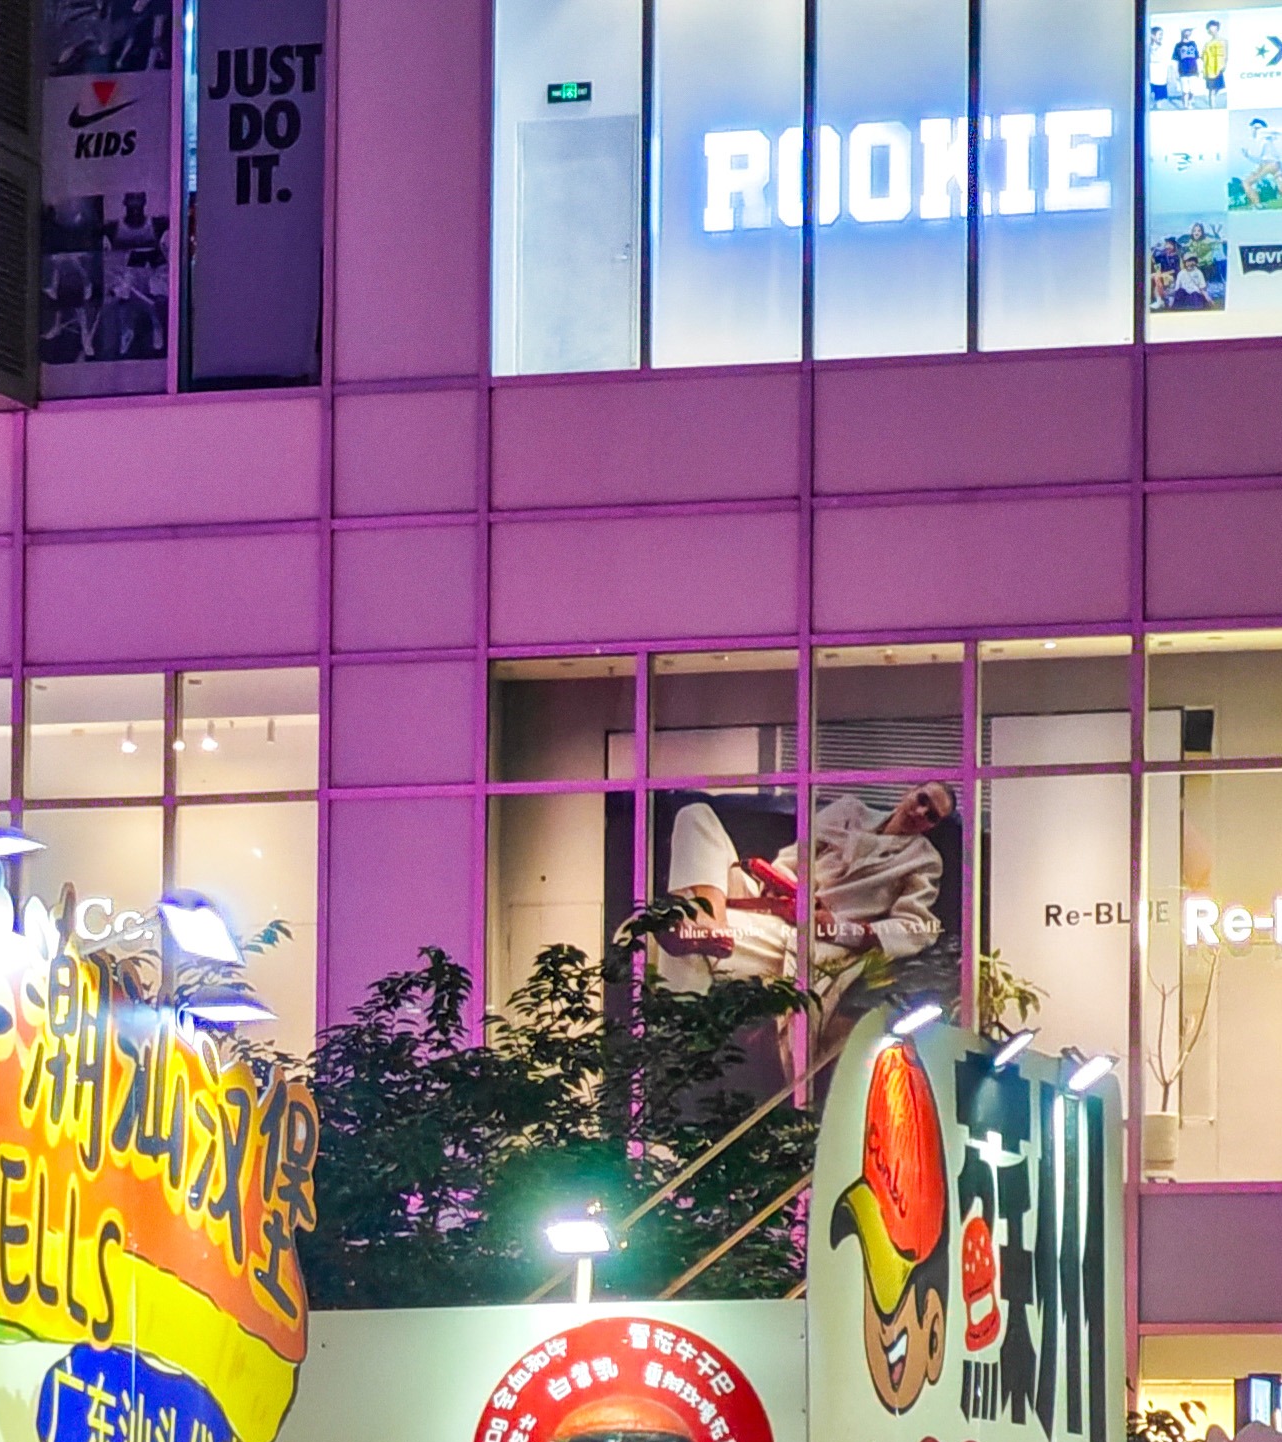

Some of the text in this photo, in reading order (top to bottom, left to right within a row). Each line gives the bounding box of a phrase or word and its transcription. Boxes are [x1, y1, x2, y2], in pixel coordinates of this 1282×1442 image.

[208, 43, 314, 100] JUST
[74, 130, 137, 159] KIDS
[229, 99, 302, 152] DO
[236, 153, 293, 206] IT.
[702, 108, 1113, 233] ROOKIE
[1045, 900, 1171, 927] Re-BLE
[1185, 897, 1282, 947] Re-
